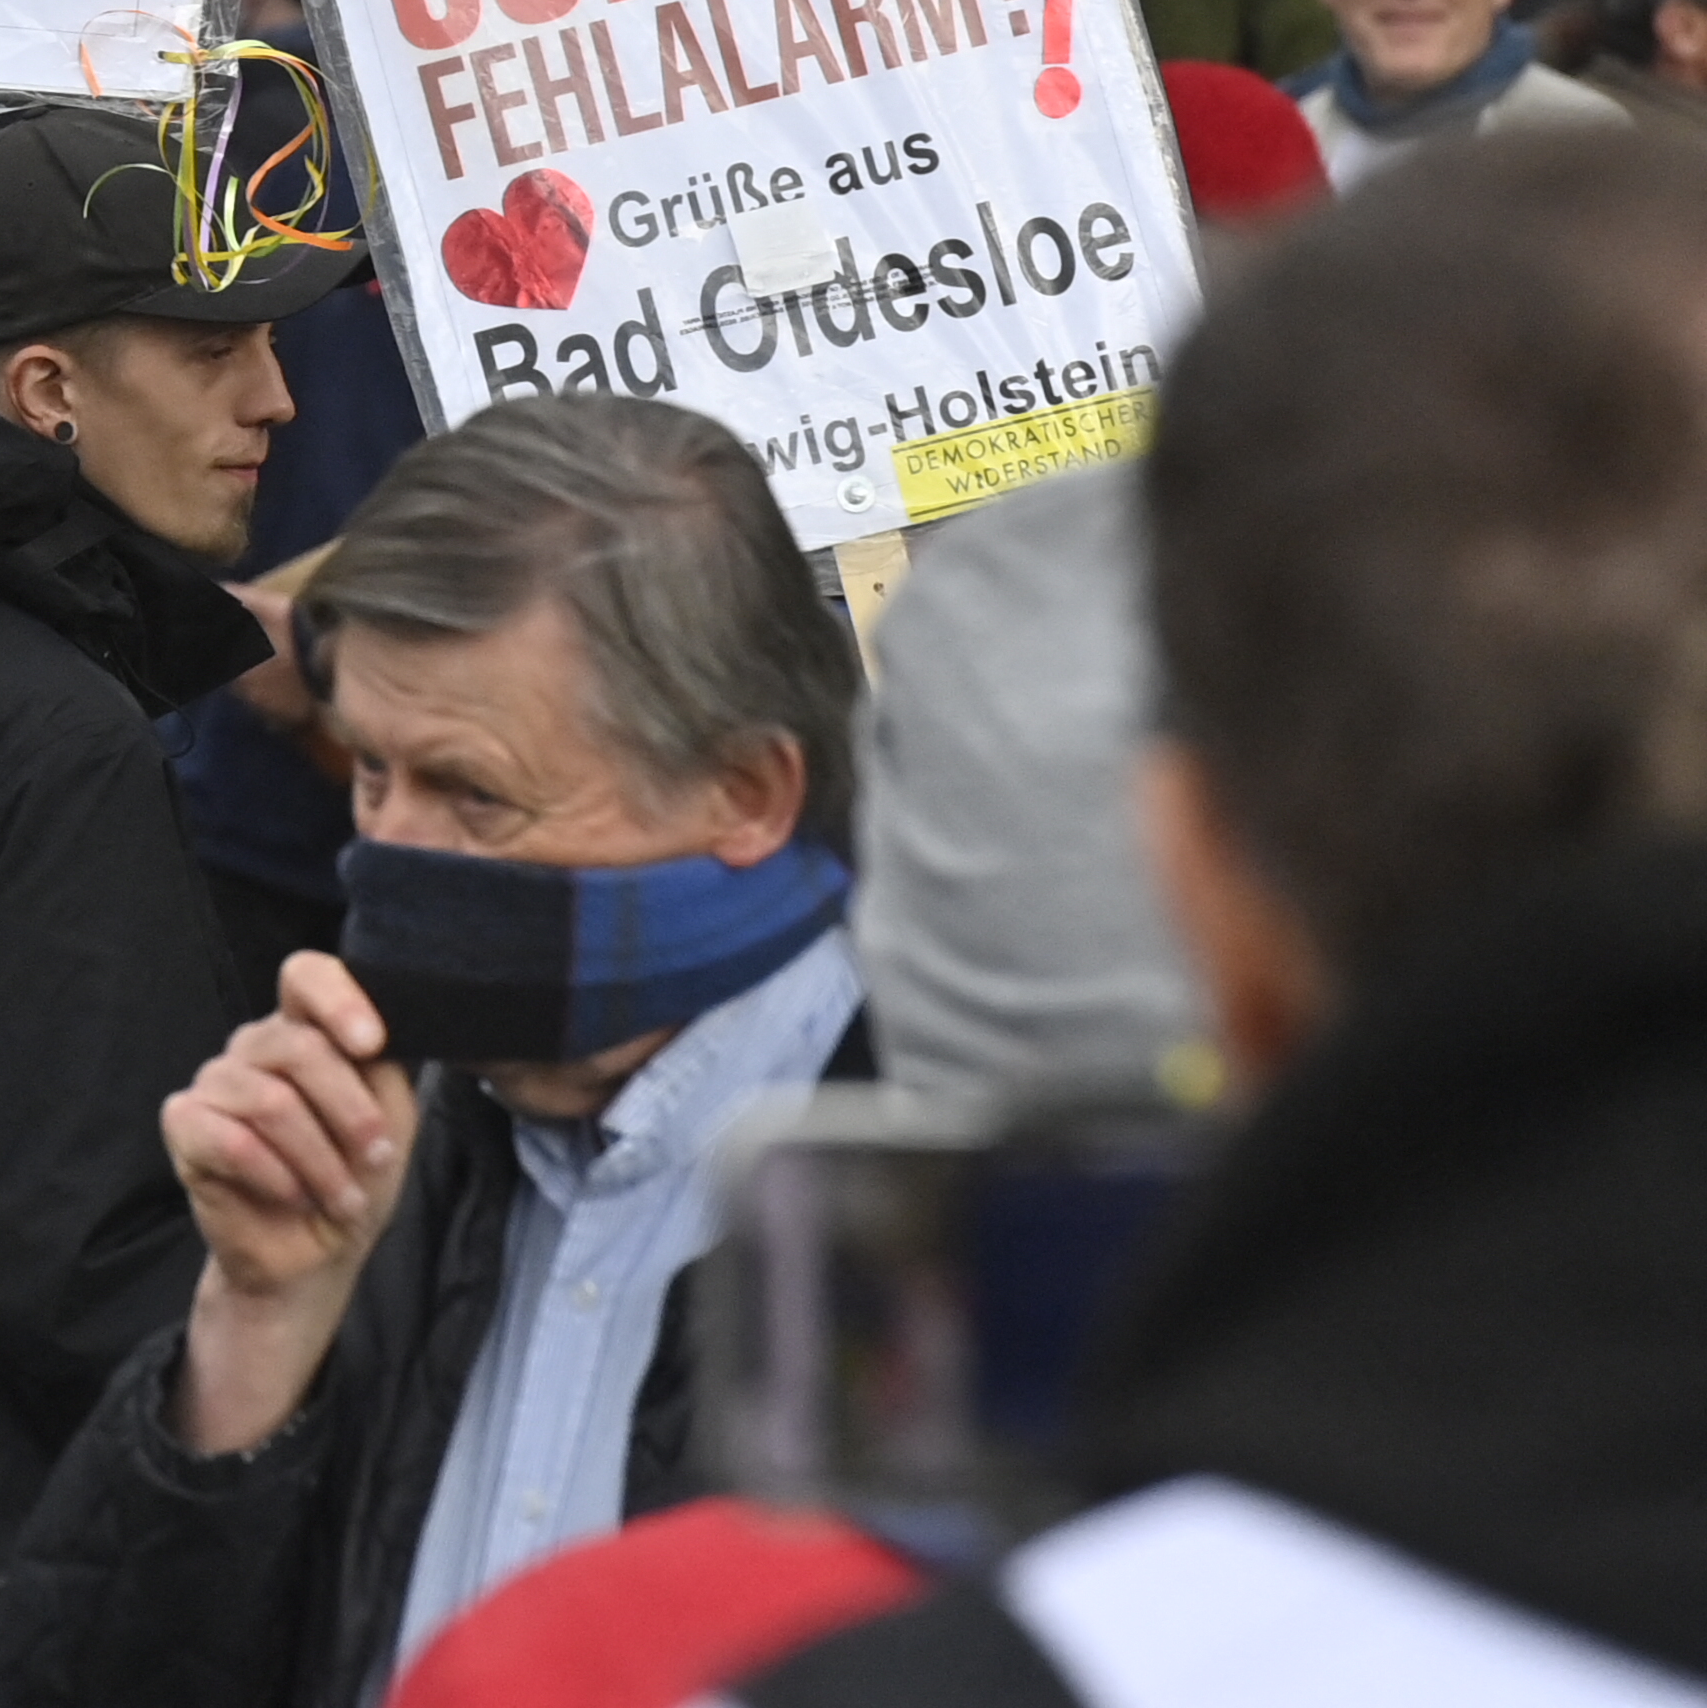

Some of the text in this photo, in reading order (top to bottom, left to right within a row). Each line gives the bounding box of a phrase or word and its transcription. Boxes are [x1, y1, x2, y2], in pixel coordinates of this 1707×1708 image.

[607, 132, 941, 250] Grüße aus
[472, 287, 680, 399] Bad
[905, 401, 1152, 475] DEMOKRATISCHER
